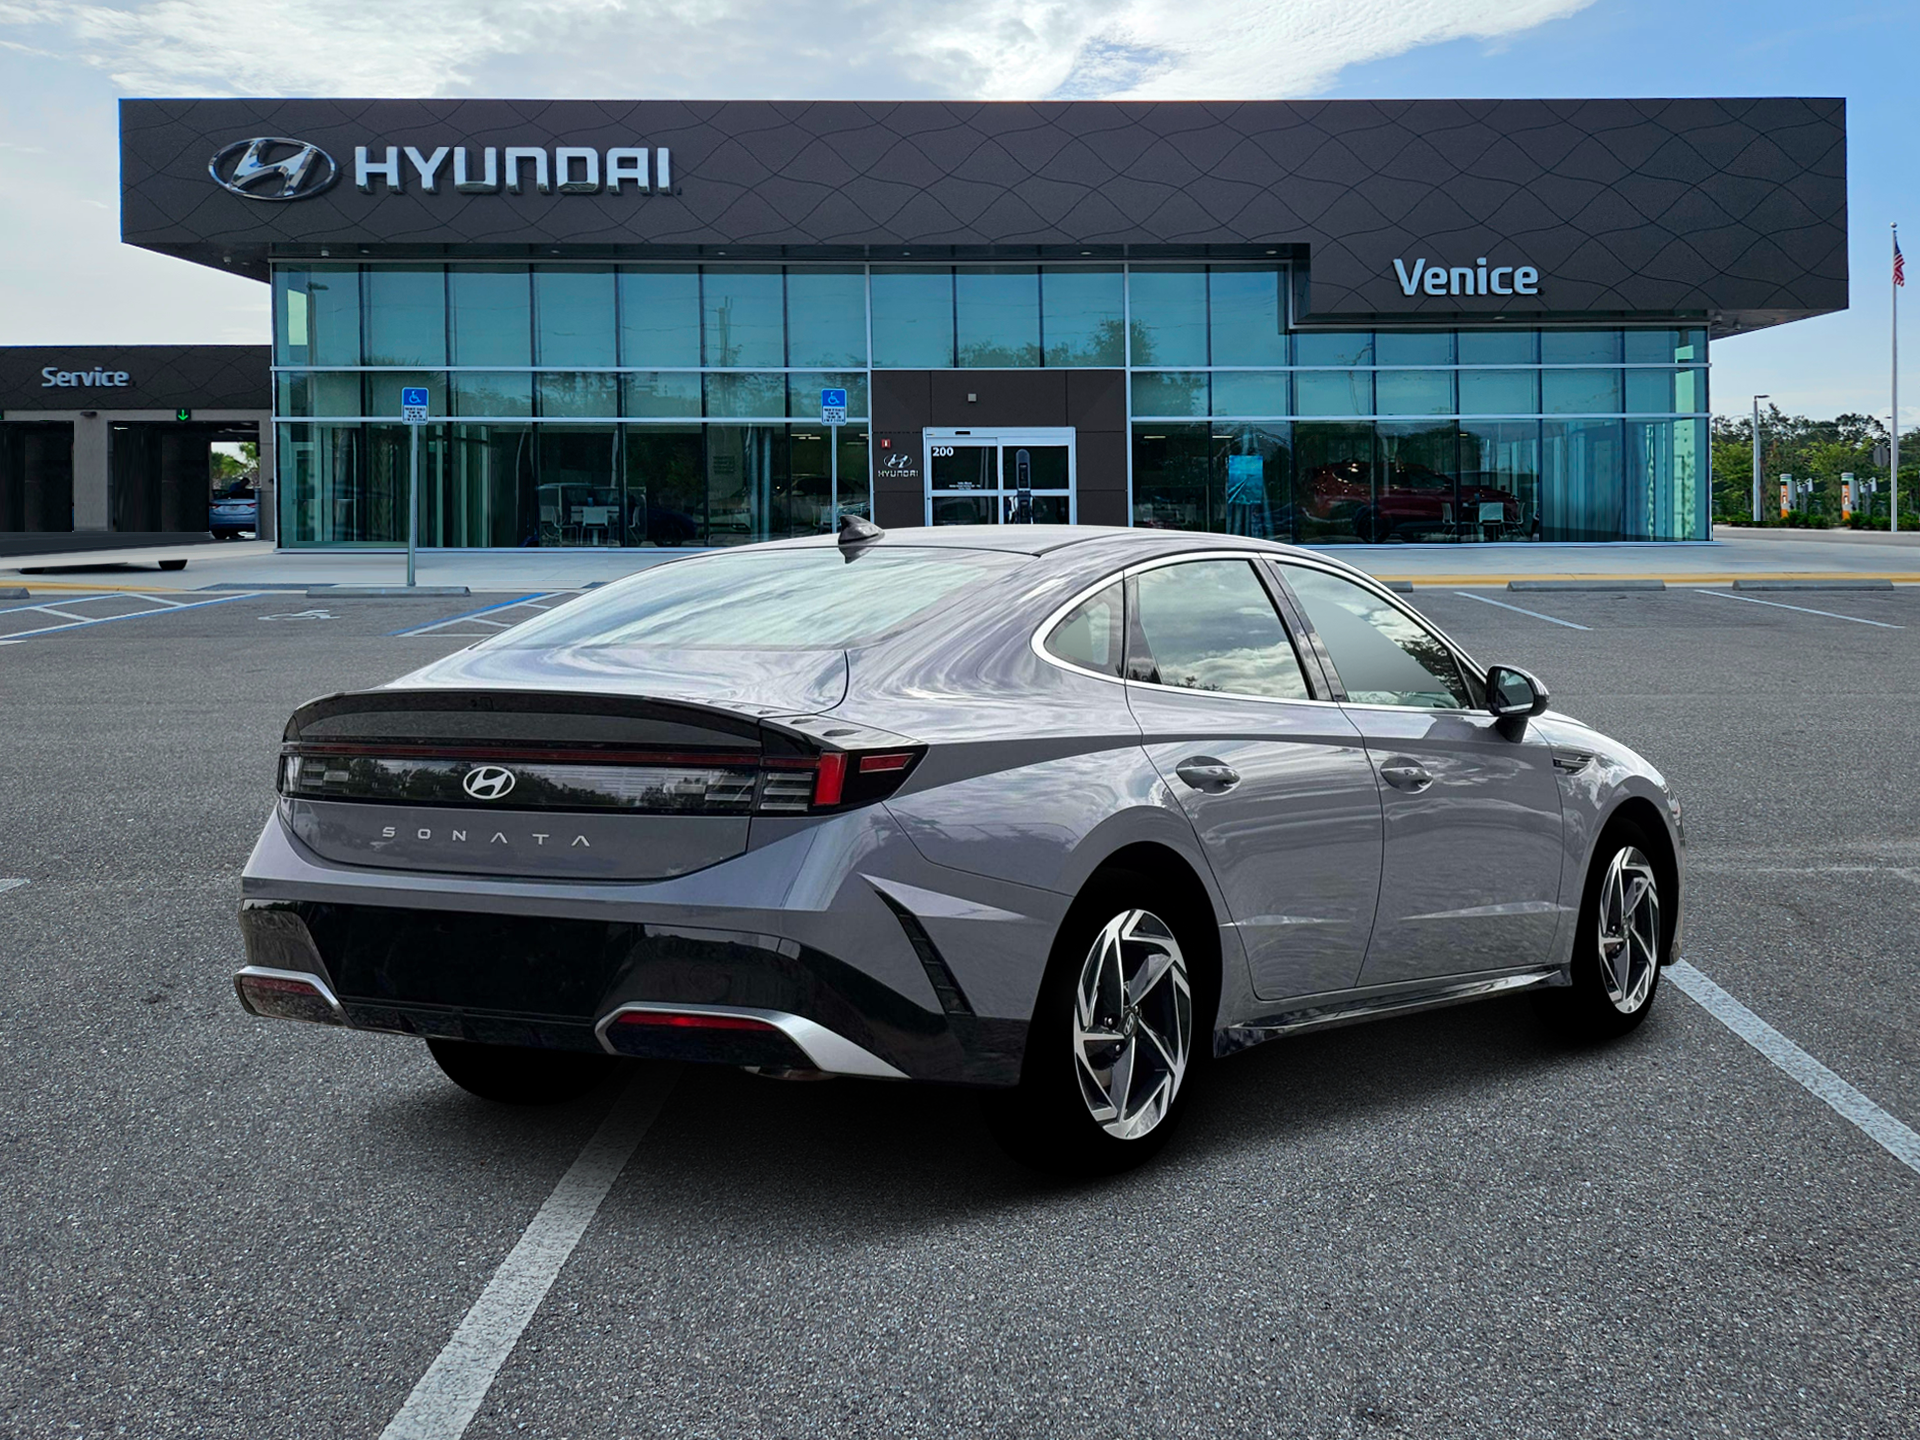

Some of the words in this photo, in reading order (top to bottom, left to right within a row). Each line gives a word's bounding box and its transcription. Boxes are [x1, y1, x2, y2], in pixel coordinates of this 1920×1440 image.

[354, 145, 672, 195] HYUNDAI
[1393, 257, 1539, 297] Venice
[41, 366, 130, 388] Service
[932, 447, 954, 457] 200
[877, 469, 919, 478] HYUNDAI
[381, 825, 591, 848] SONATA
